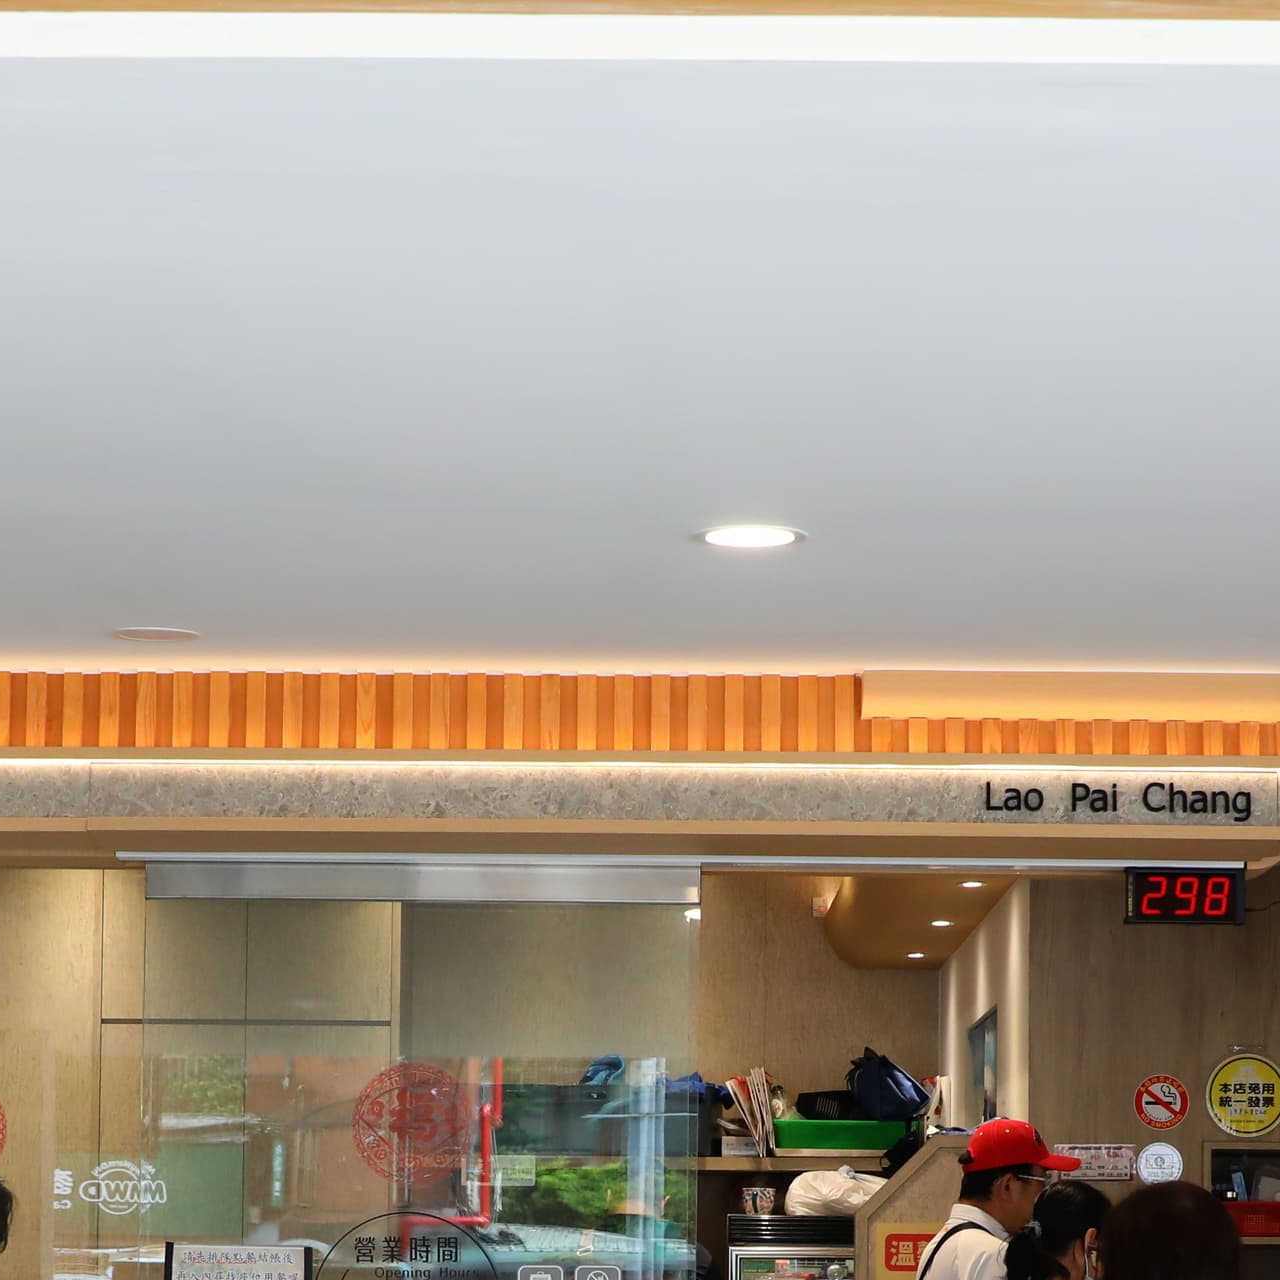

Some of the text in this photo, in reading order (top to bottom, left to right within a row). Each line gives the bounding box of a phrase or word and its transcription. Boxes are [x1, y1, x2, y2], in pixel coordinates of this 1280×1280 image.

[985, 781, 1252, 822] Lao Pai Chang
[1141, 876, 1230, 915] 298
[1219, 1083, 1275, 1095] 本店免用
[1219, 1096, 1275, 1108] 統一發票
[1151, 1114, 1183, 1128] SMOKING
[354, 1236, 459, 1263] 營業時間
[375, 1267, 431, 1280] Opening
